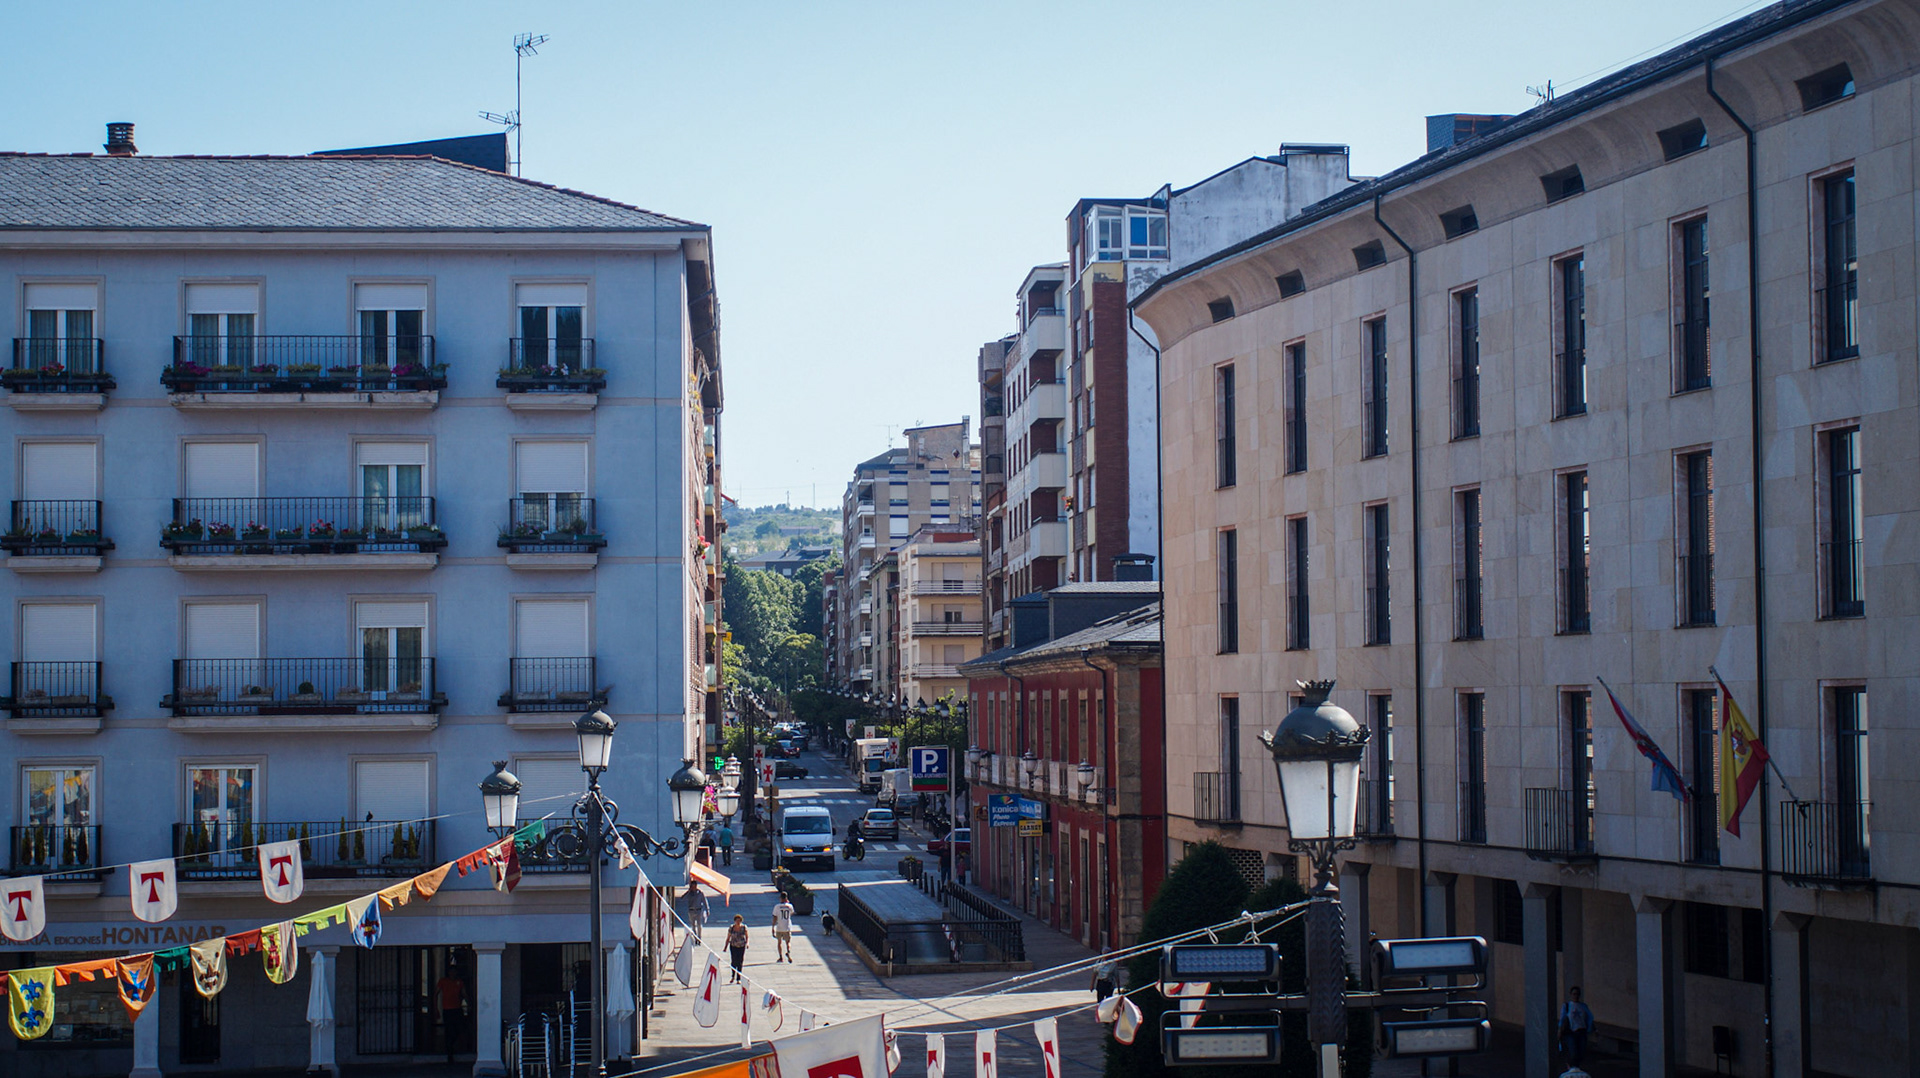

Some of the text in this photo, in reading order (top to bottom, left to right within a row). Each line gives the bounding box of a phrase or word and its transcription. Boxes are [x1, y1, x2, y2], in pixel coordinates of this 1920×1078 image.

[921, 749, 939, 773] P
[992, 805, 1019, 813] Konica
[780, 909, 790, 920] 10
[54, 935, 102, 946] EDICIONES
[102, 926, 226, 945] HONTANAR
